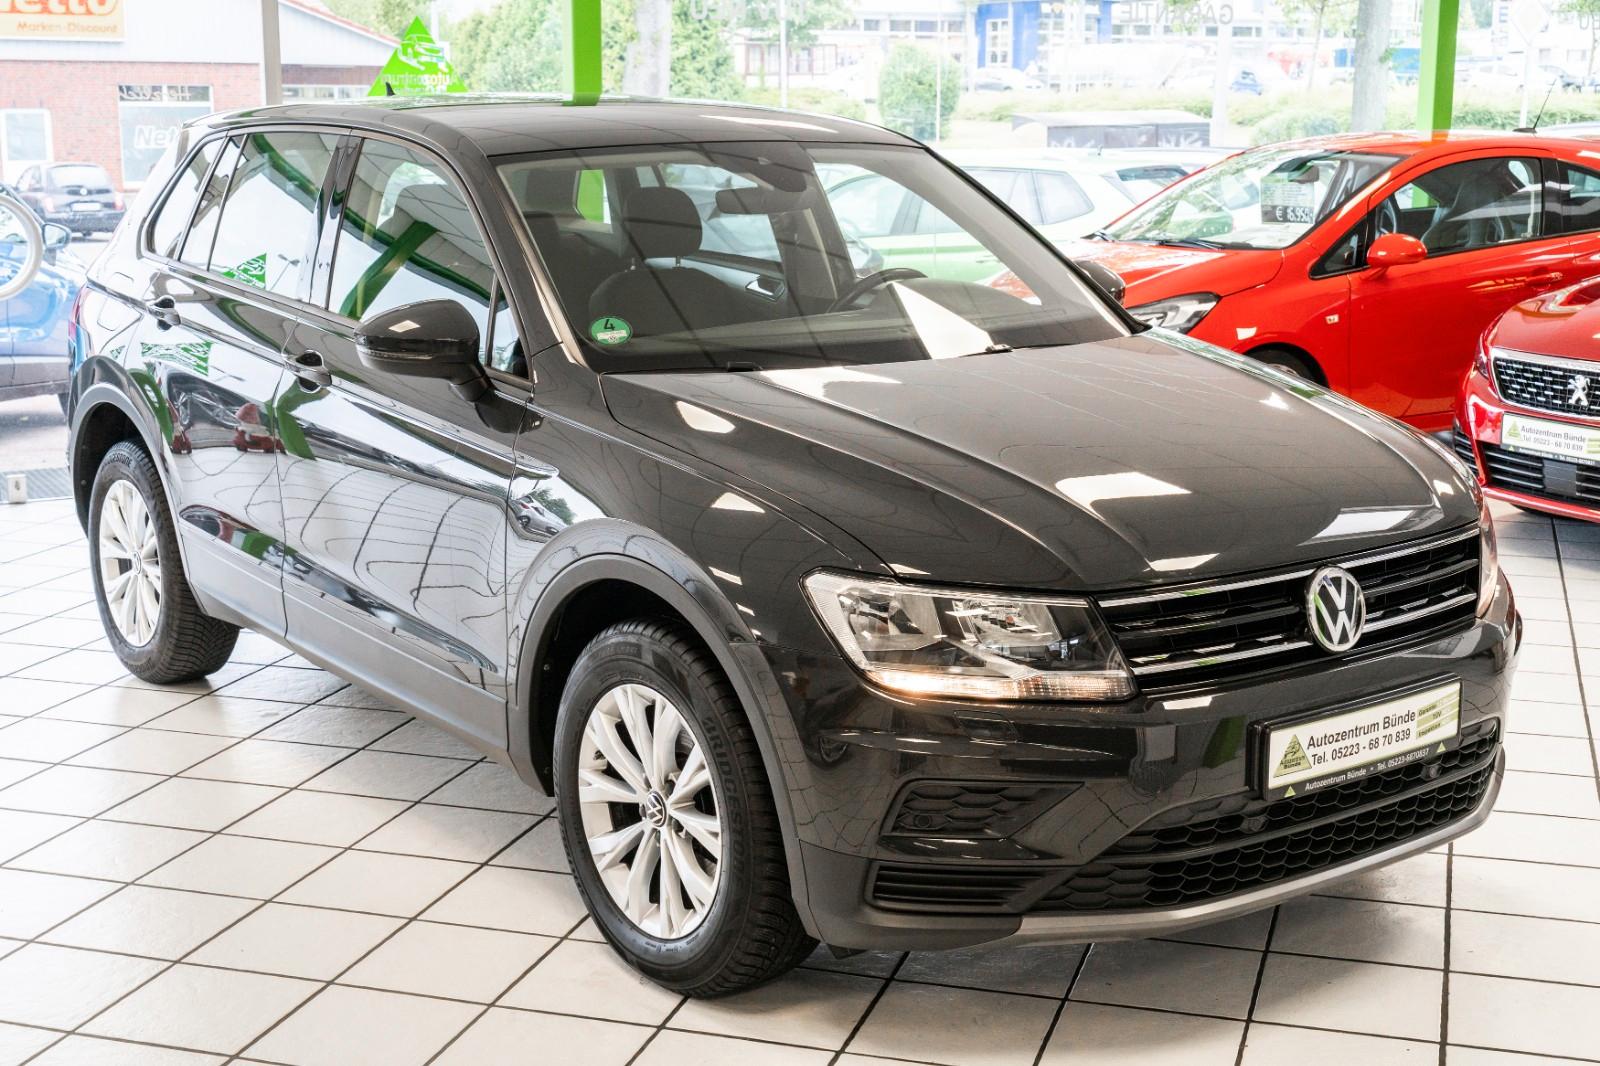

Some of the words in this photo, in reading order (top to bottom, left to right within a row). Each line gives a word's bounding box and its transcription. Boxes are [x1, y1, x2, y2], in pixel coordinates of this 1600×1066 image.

[604, 319, 616, 331] 4
[1307, 721, 1380, 750] Autozentrum
[1382, 710, 1416, 730] Bünde
[1312, 753, 1329, 766] Tel.
[1331, 742, 1360, 761] 05223
[1368, 737, 1380, 750] 68
[1382, 733, 1393, 747] 70
[1395, 728, 1411, 743] 839
[1305, 774, 1346, 791] Autozentrum
[1347, 767, 1367, 780] Bünde
